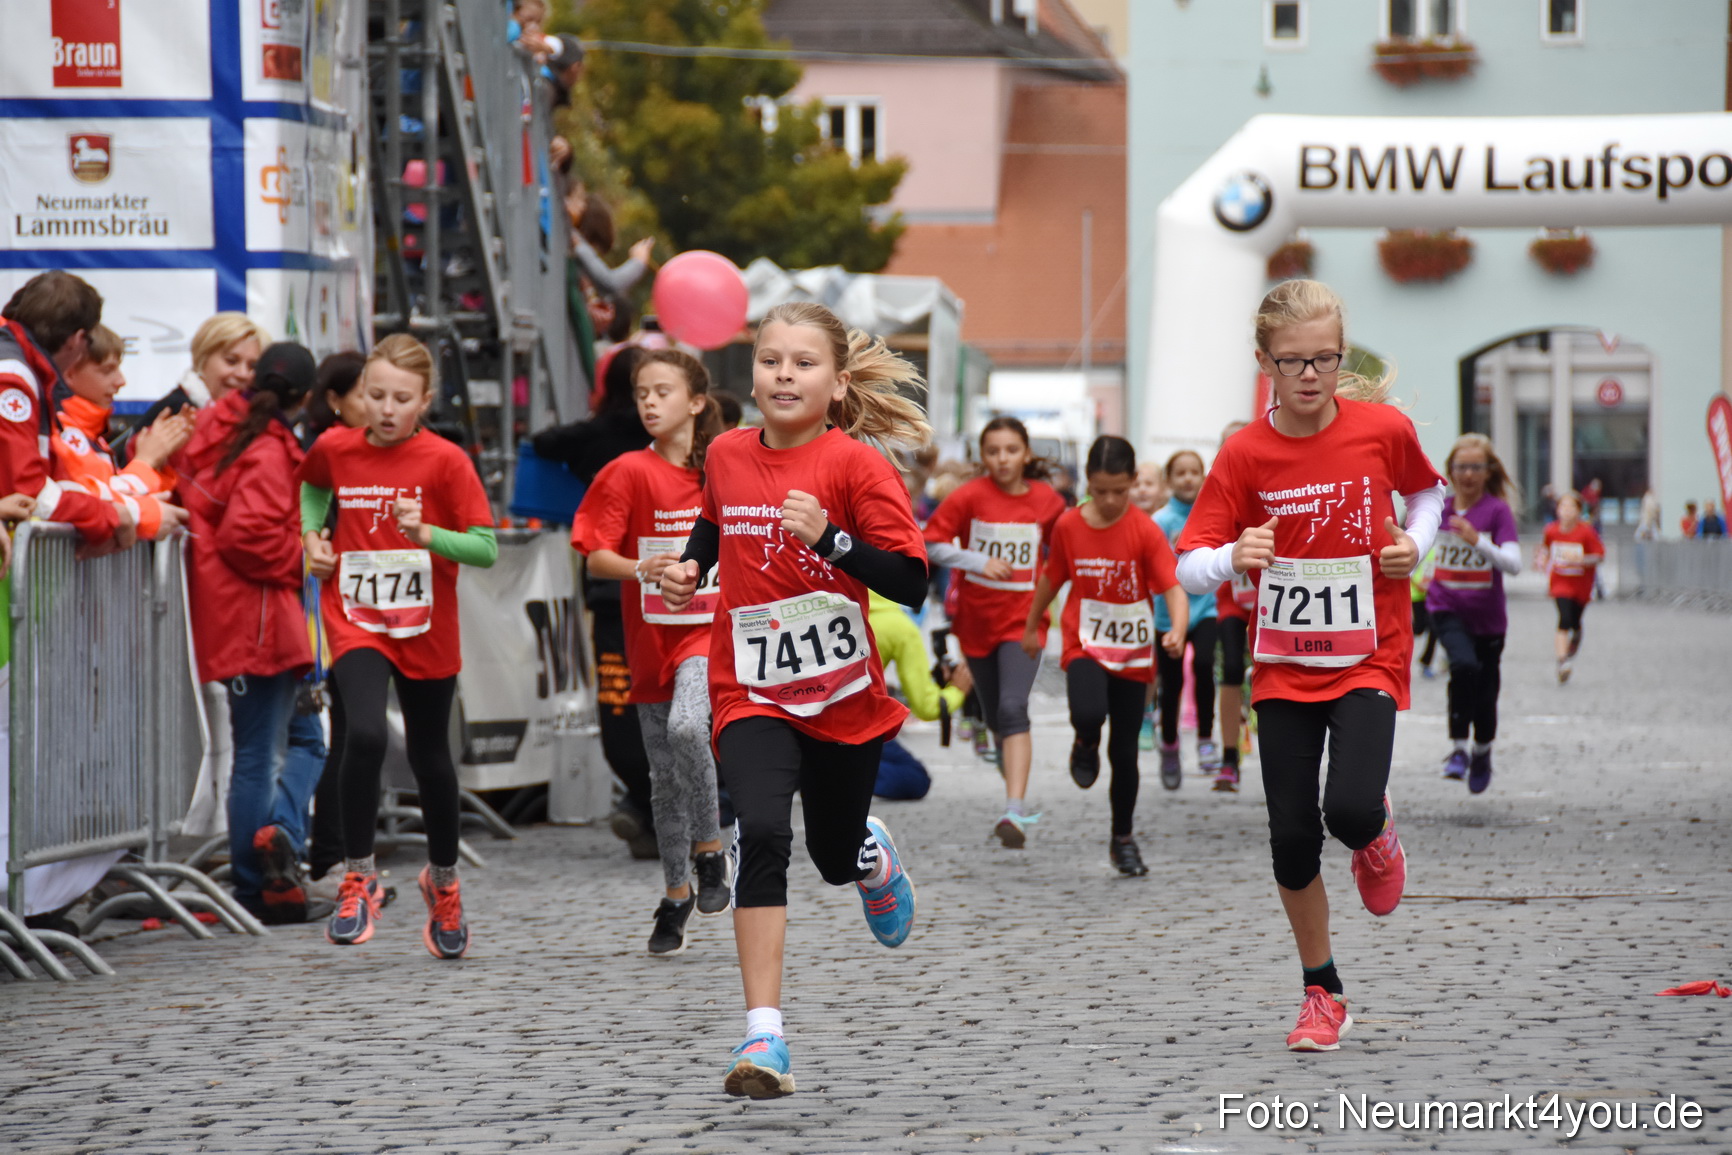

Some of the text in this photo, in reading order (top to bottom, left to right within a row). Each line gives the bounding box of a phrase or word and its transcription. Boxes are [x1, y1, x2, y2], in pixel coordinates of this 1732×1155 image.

[51, 36, 117, 68] Braun
[1299, 145, 1464, 191] BMW
[1485, 142, 1732, 200] Laufspo
[36, 193, 149, 211] Neumarkter
[15, 213, 169, 237] Lammsbräu
[1258, 482, 1336, 501] Neumarkter
[654, 506, 703, 520] Neumark
[722, 504, 783, 518] Neumarkte
[1264, 498, 1321, 516] Stadtlauf
[1363, 476, 1372, 546] BAMBINI
[654, 520, 696, 533] Stadtla
[722, 521, 774, 539] Stadtlauf
[1302, 561, 1361, 576] BOCK
[349, 571, 424, 605] 7174
[780, 593, 848, 620] BOCK
[1268, 583, 1360, 626] 7211
[1089, 618, 1149, 644] 7426
[747, 616, 857, 681] 7413
[1294, 637, 1333, 653] Lena
[777, 684, 826, 700] Emma
